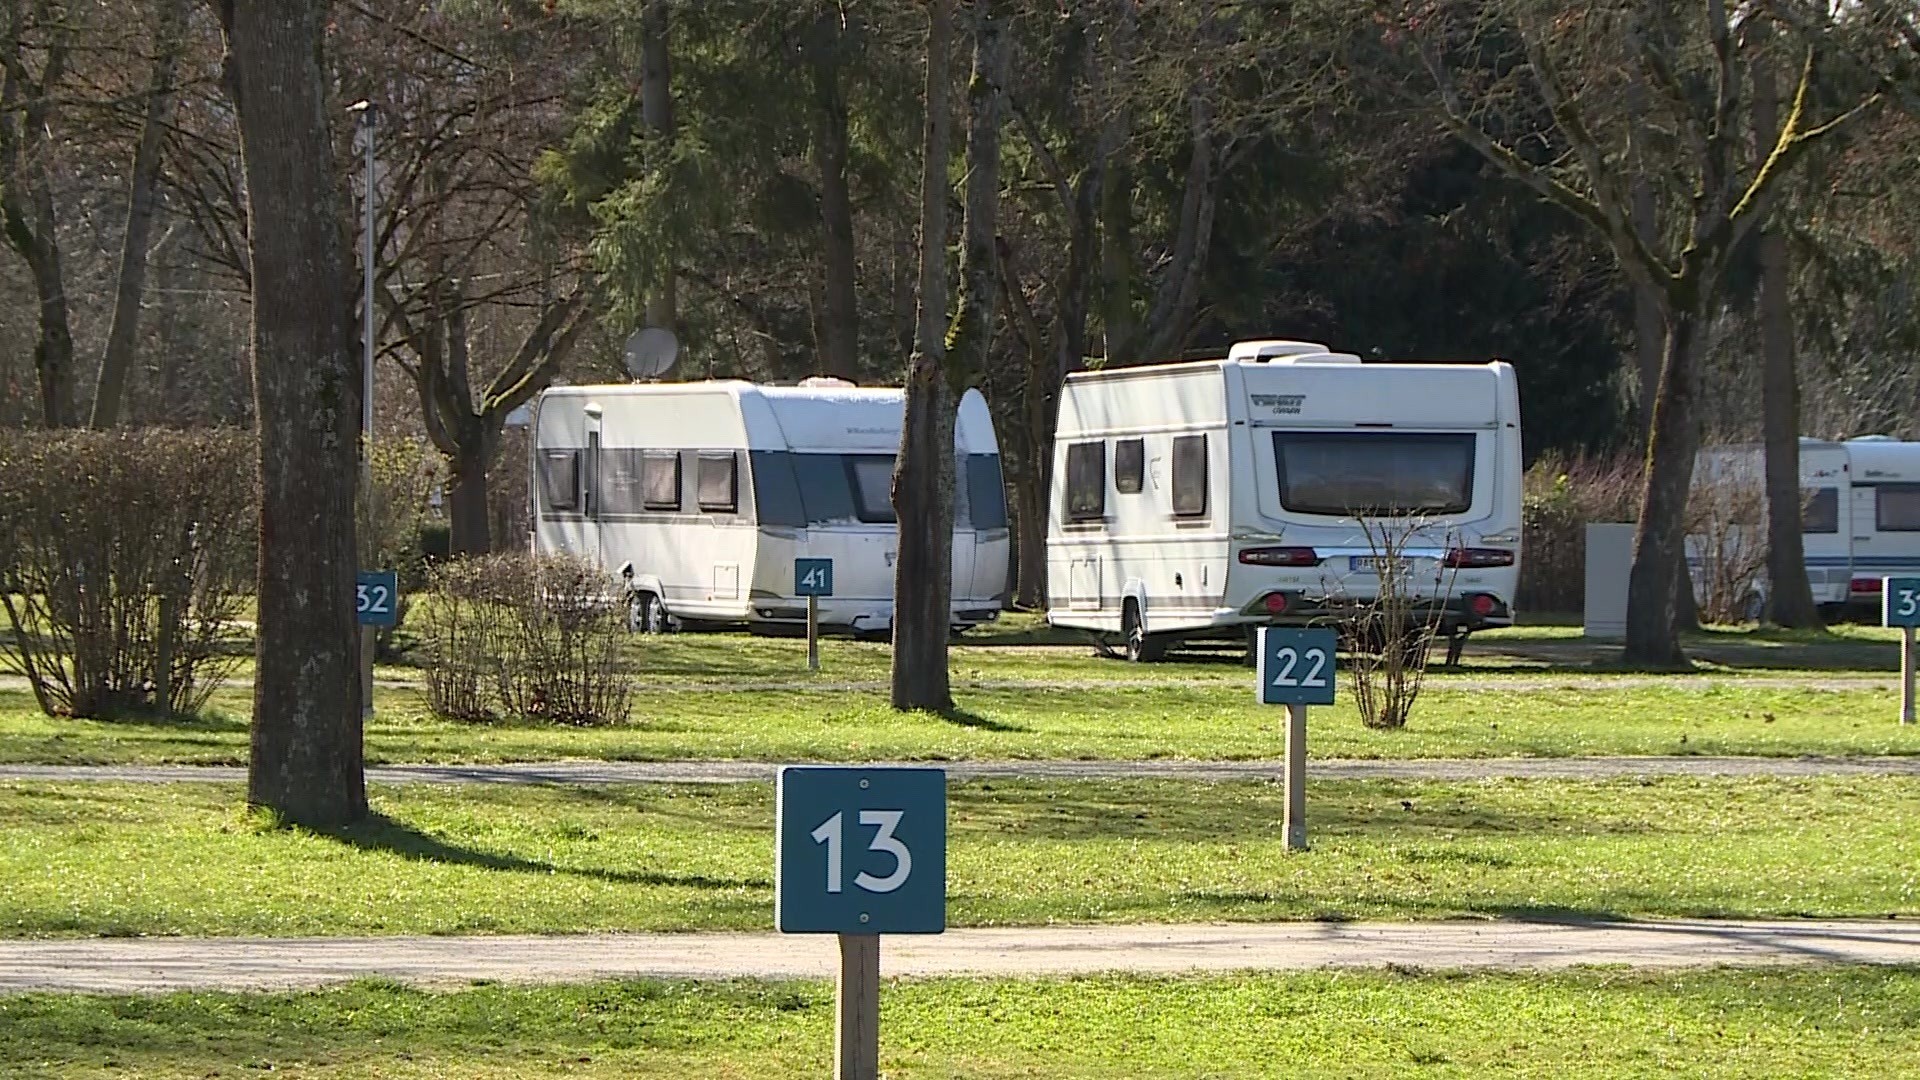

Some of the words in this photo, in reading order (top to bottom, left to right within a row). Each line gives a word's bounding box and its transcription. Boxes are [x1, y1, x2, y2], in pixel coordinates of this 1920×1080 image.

[801, 568, 825, 588] 41
[1898, 589, 1920, 616] 3
[1272, 647, 1326, 687] 22
[811, 811, 912, 893] 13
